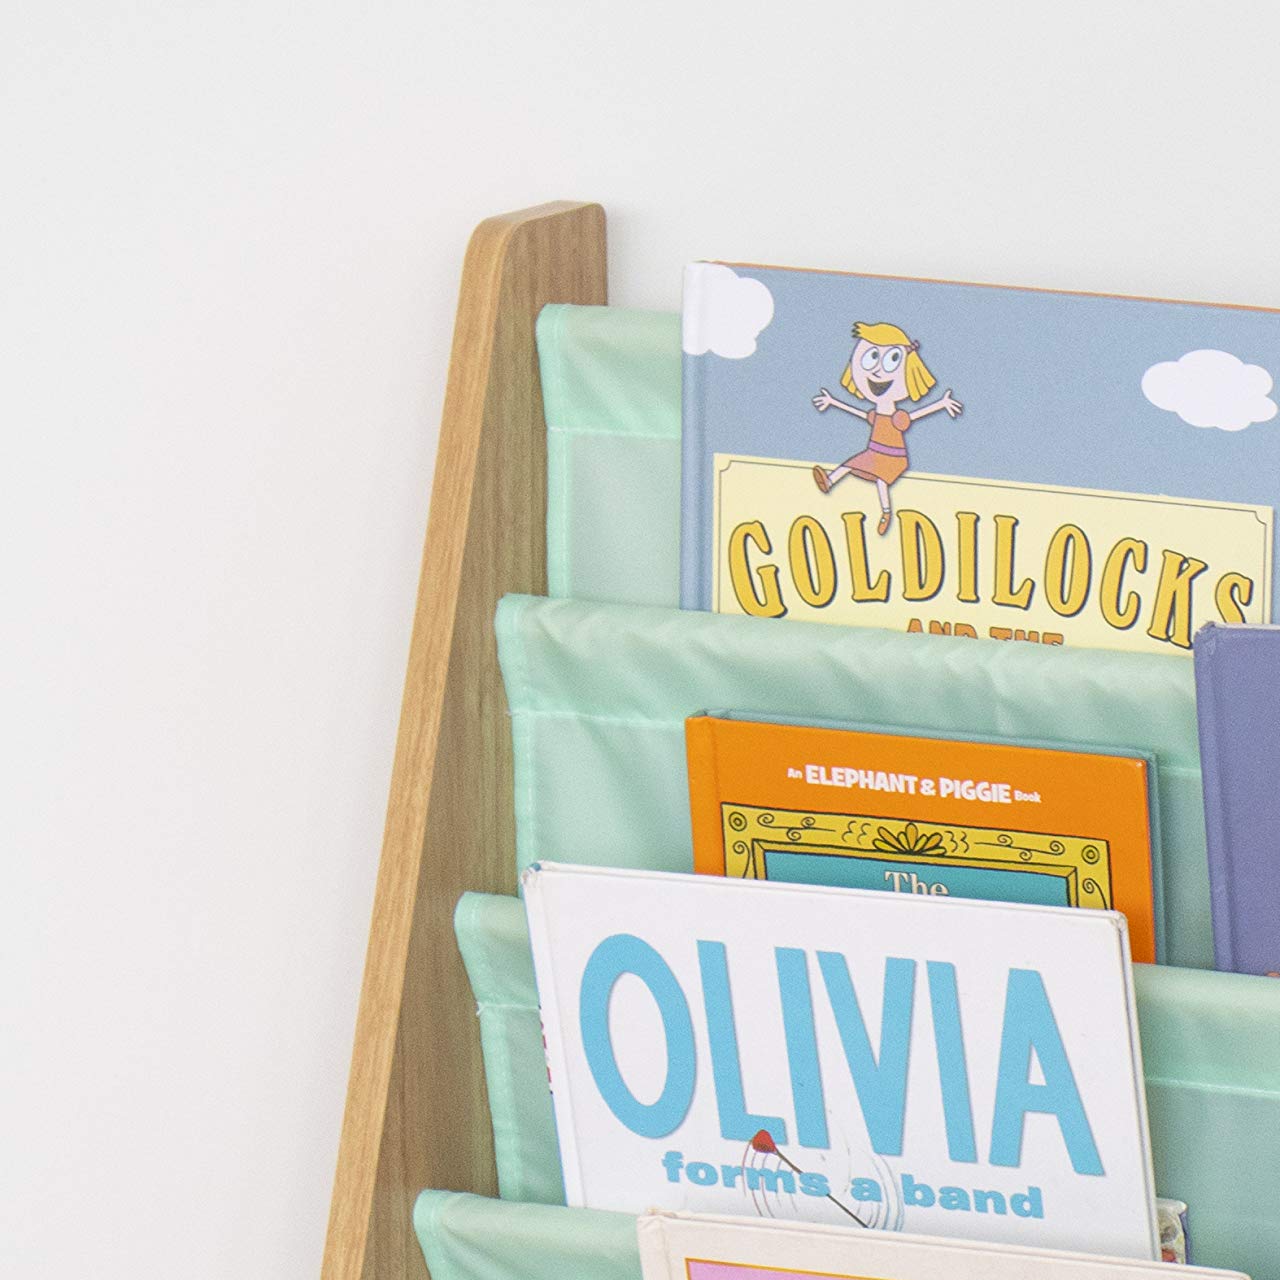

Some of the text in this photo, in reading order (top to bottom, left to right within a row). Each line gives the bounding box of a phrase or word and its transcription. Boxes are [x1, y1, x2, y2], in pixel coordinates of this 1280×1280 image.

[727, 509, 1255, 650] GOLDILOCKS
[787, 764, 1042, 804] An ELEPHANT & PIGGIE Book
[884, 870, 950, 897] The
[579, 932, 1107, 1177] OLIVIA
[661, 1150, 1046, 1221] forms a band
